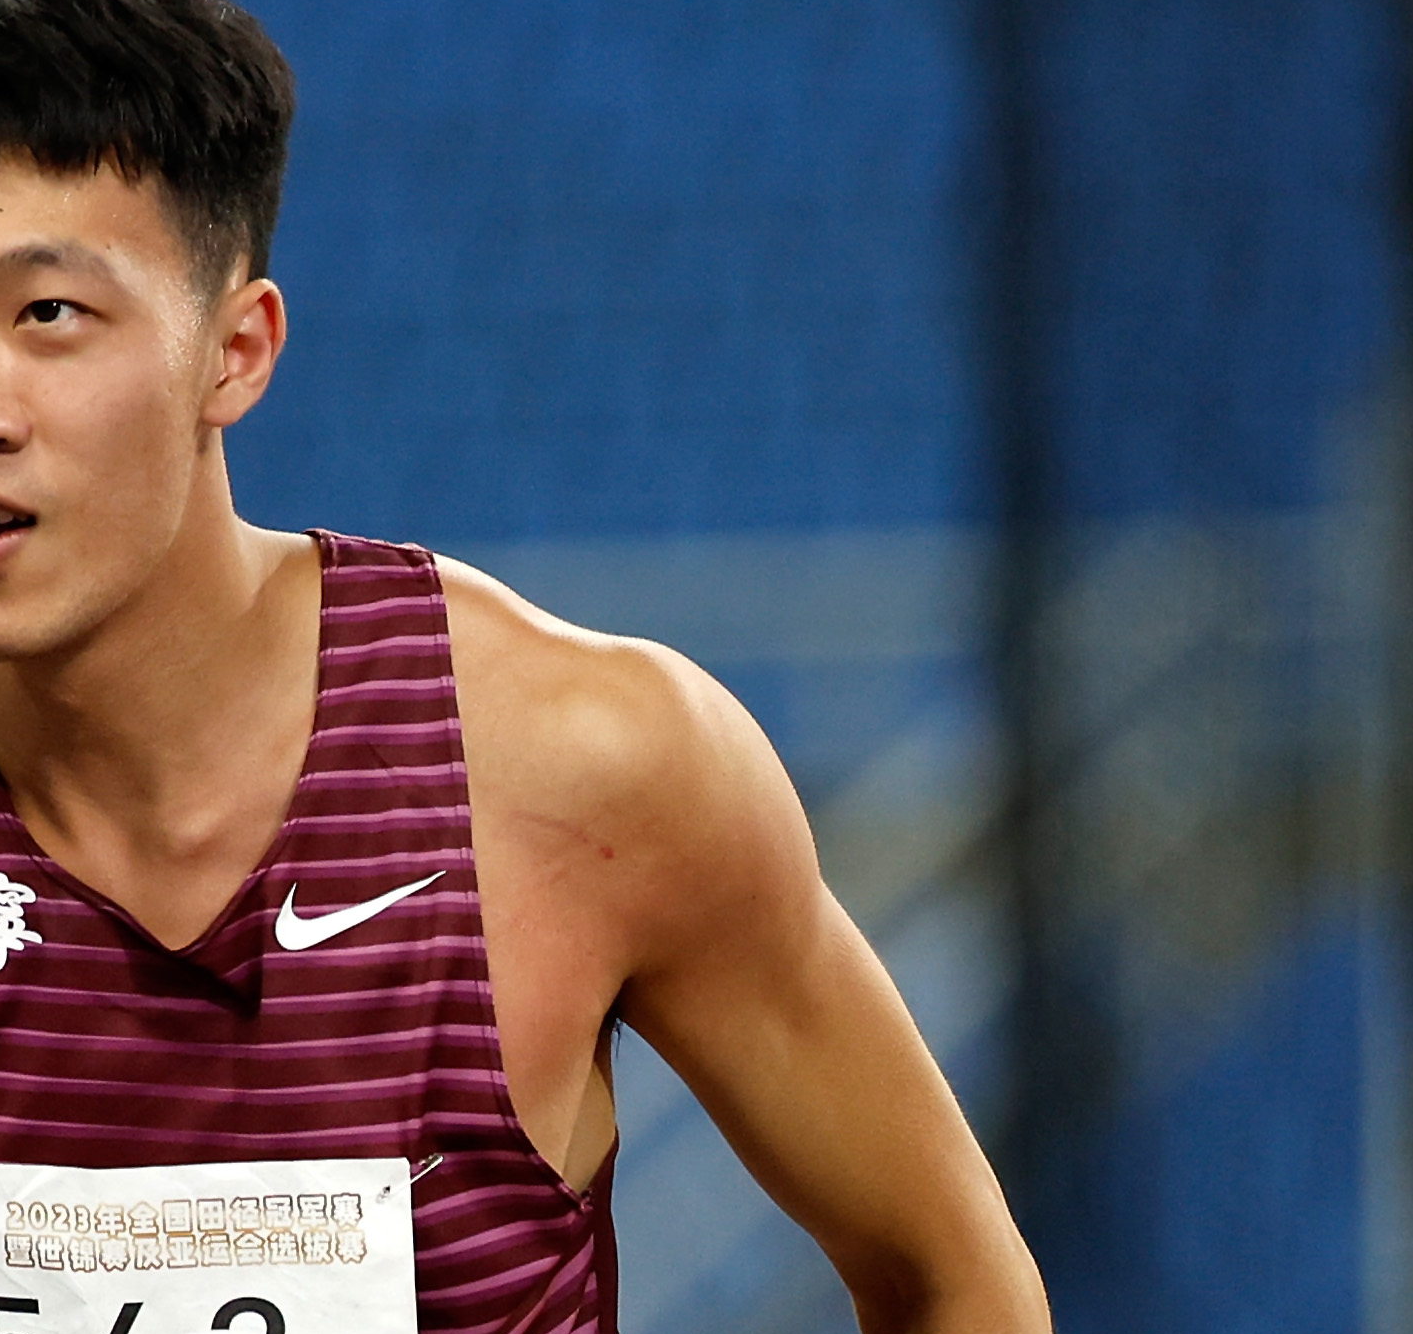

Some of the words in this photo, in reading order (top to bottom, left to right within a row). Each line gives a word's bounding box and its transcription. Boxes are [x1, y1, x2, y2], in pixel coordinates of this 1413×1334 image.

[6, 1192, 363, 1236] 2023年全国田径冠军赛
[4, 1227, 368, 1272] 暨世锦赛及亚运会选拔赛
